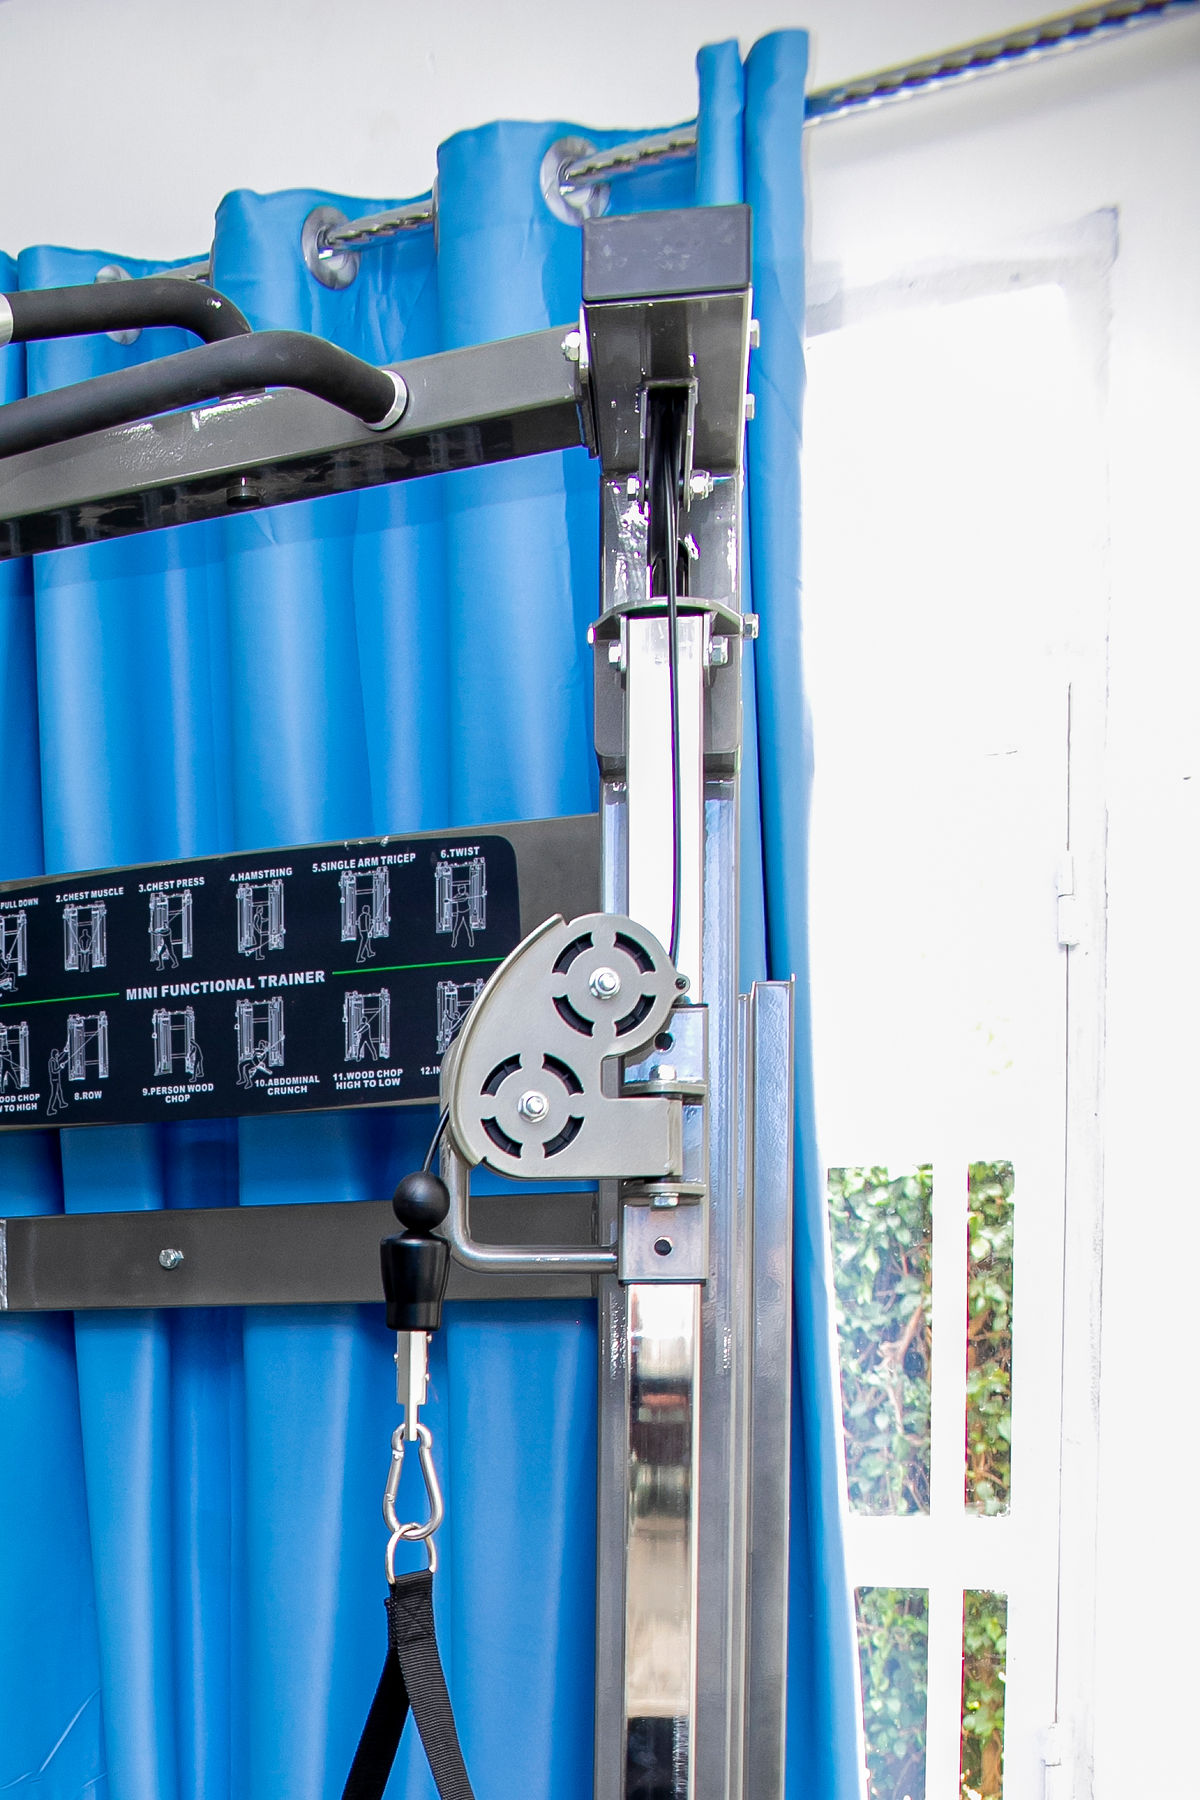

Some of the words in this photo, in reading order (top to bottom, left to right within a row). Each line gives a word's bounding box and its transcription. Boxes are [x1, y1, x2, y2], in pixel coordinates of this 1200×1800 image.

[440, 846, 481, 859] 6.TWIST
[312, 856, 356, 873] 5.SINGLE
[358, 858, 379, 868] ARM
[381, 852, 416, 866] TRICEP
[230, 866, 293, 882] 4.HAMSTRING
[138, 880, 174, 893] 3.CHEST
[177, 876, 206, 888] PRESS
[56, 892, 90, 903] 2.CHEST
[91, 886, 124, 898] MUSCLE
[1, 900, 18, 910] PULL
[18, 897, 39, 907] DOWN
[126, 986, 157, 1001] MINI
[160, 978, 255, 998] FUNCTIONAL
[258, 970, 326, 988] TRAINER
[332, 1070, 375, 1081] 11.WOOD
[376, 1068, 404, 1078] CHOP
[254, 1076, 321, 1088] 10.ABDOMINAL
[336, 1080, 362, 1090] HIGH
[363, 1080, 377, 1088] TO
[378, 1078, 401, 1087] LOW
[74, 1090, 103, 1101] 8.ROW
[142, 1086, 187, 1097] 9.PERSON
[188, 1084, 215, 1093] WOOD
[266, 1086, 308, 1096] CRUNCH
[17, 1092, 40, 1103] CHOP
[165, 1094, 191, 1104] CHOP
[4, 1104, 15, 1113] TO
[16, 1102, 38, 1112] HIGH
